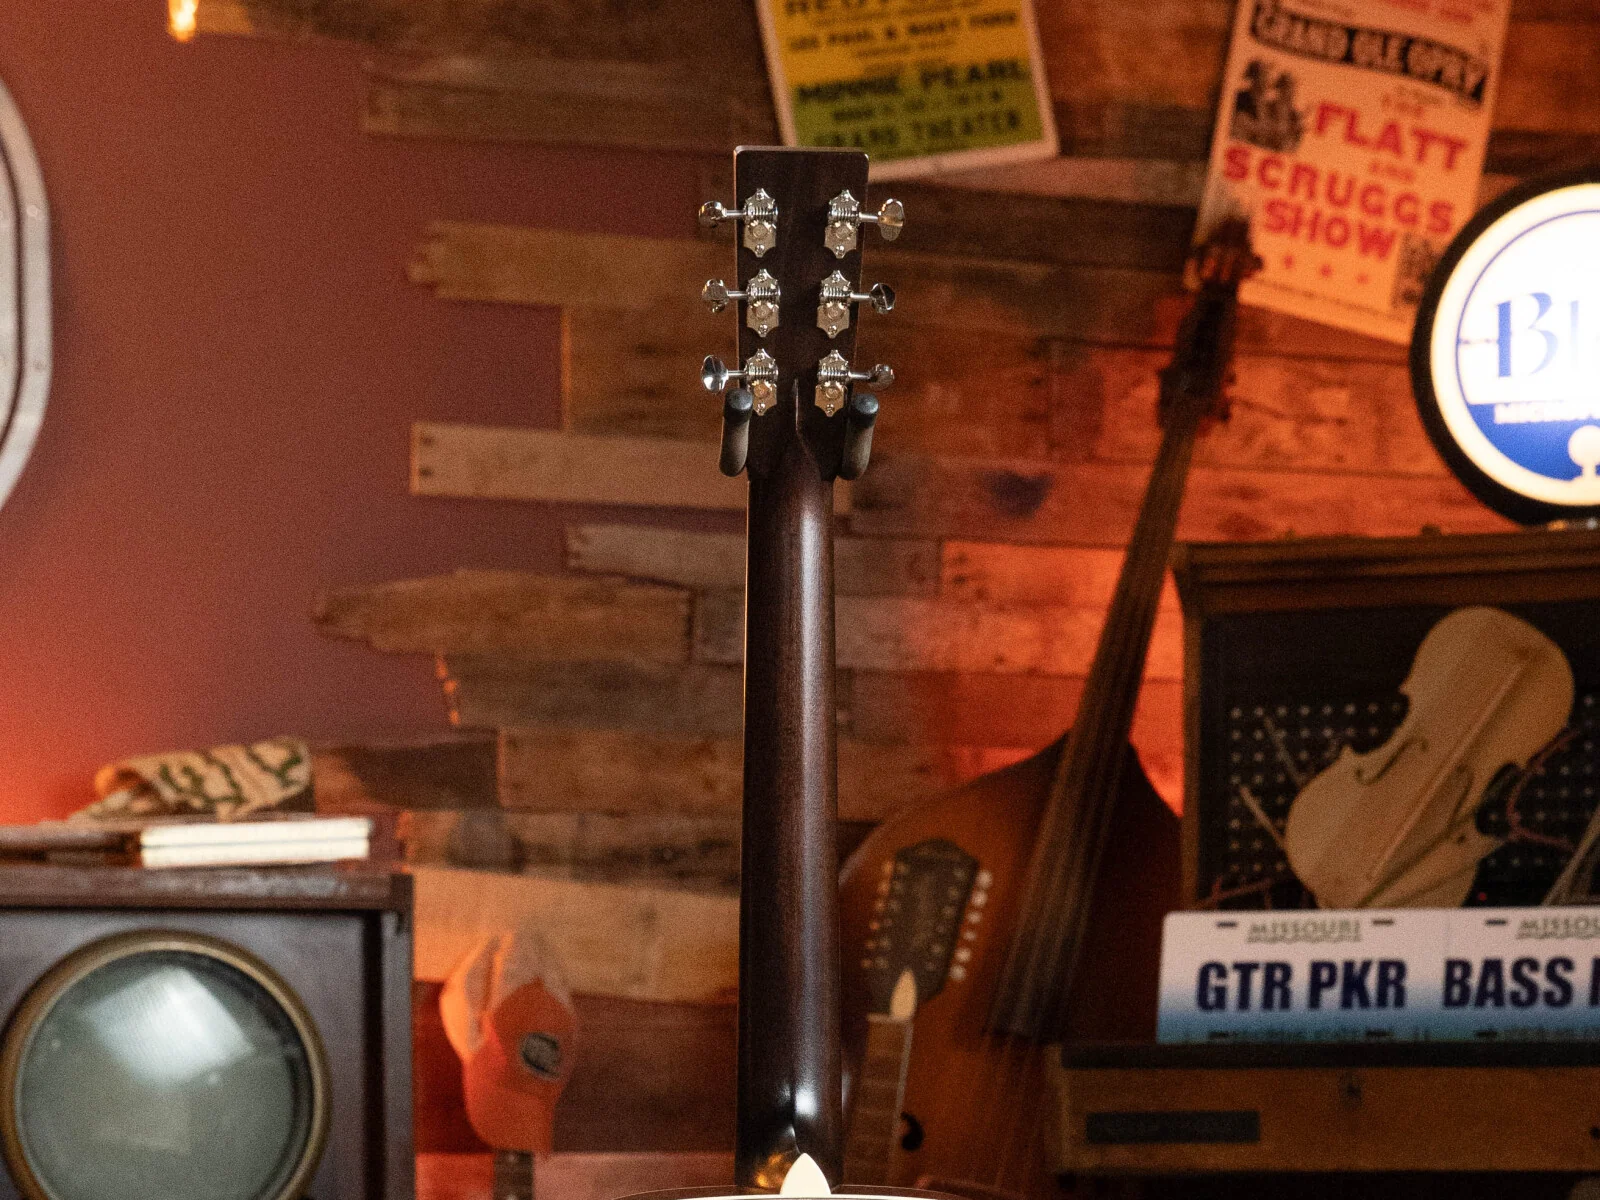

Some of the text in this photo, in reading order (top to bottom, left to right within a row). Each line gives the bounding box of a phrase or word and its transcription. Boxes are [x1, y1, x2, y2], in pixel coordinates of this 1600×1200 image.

[917, 61, 1029, 90] PEARL
[1316, 101, 1469, 171] FLATT
[1224, 145, 1454, 235] SCRUGGS
[1263, 198, 1396, 262] SHOW
[1497, 291, 1580, 378] Bl
[1249, 917, 1361, 940] MISSOURI
[1198, 958, 1407, 1011] GTR PKR
[1442, 956, 1575, 1009] BASS
